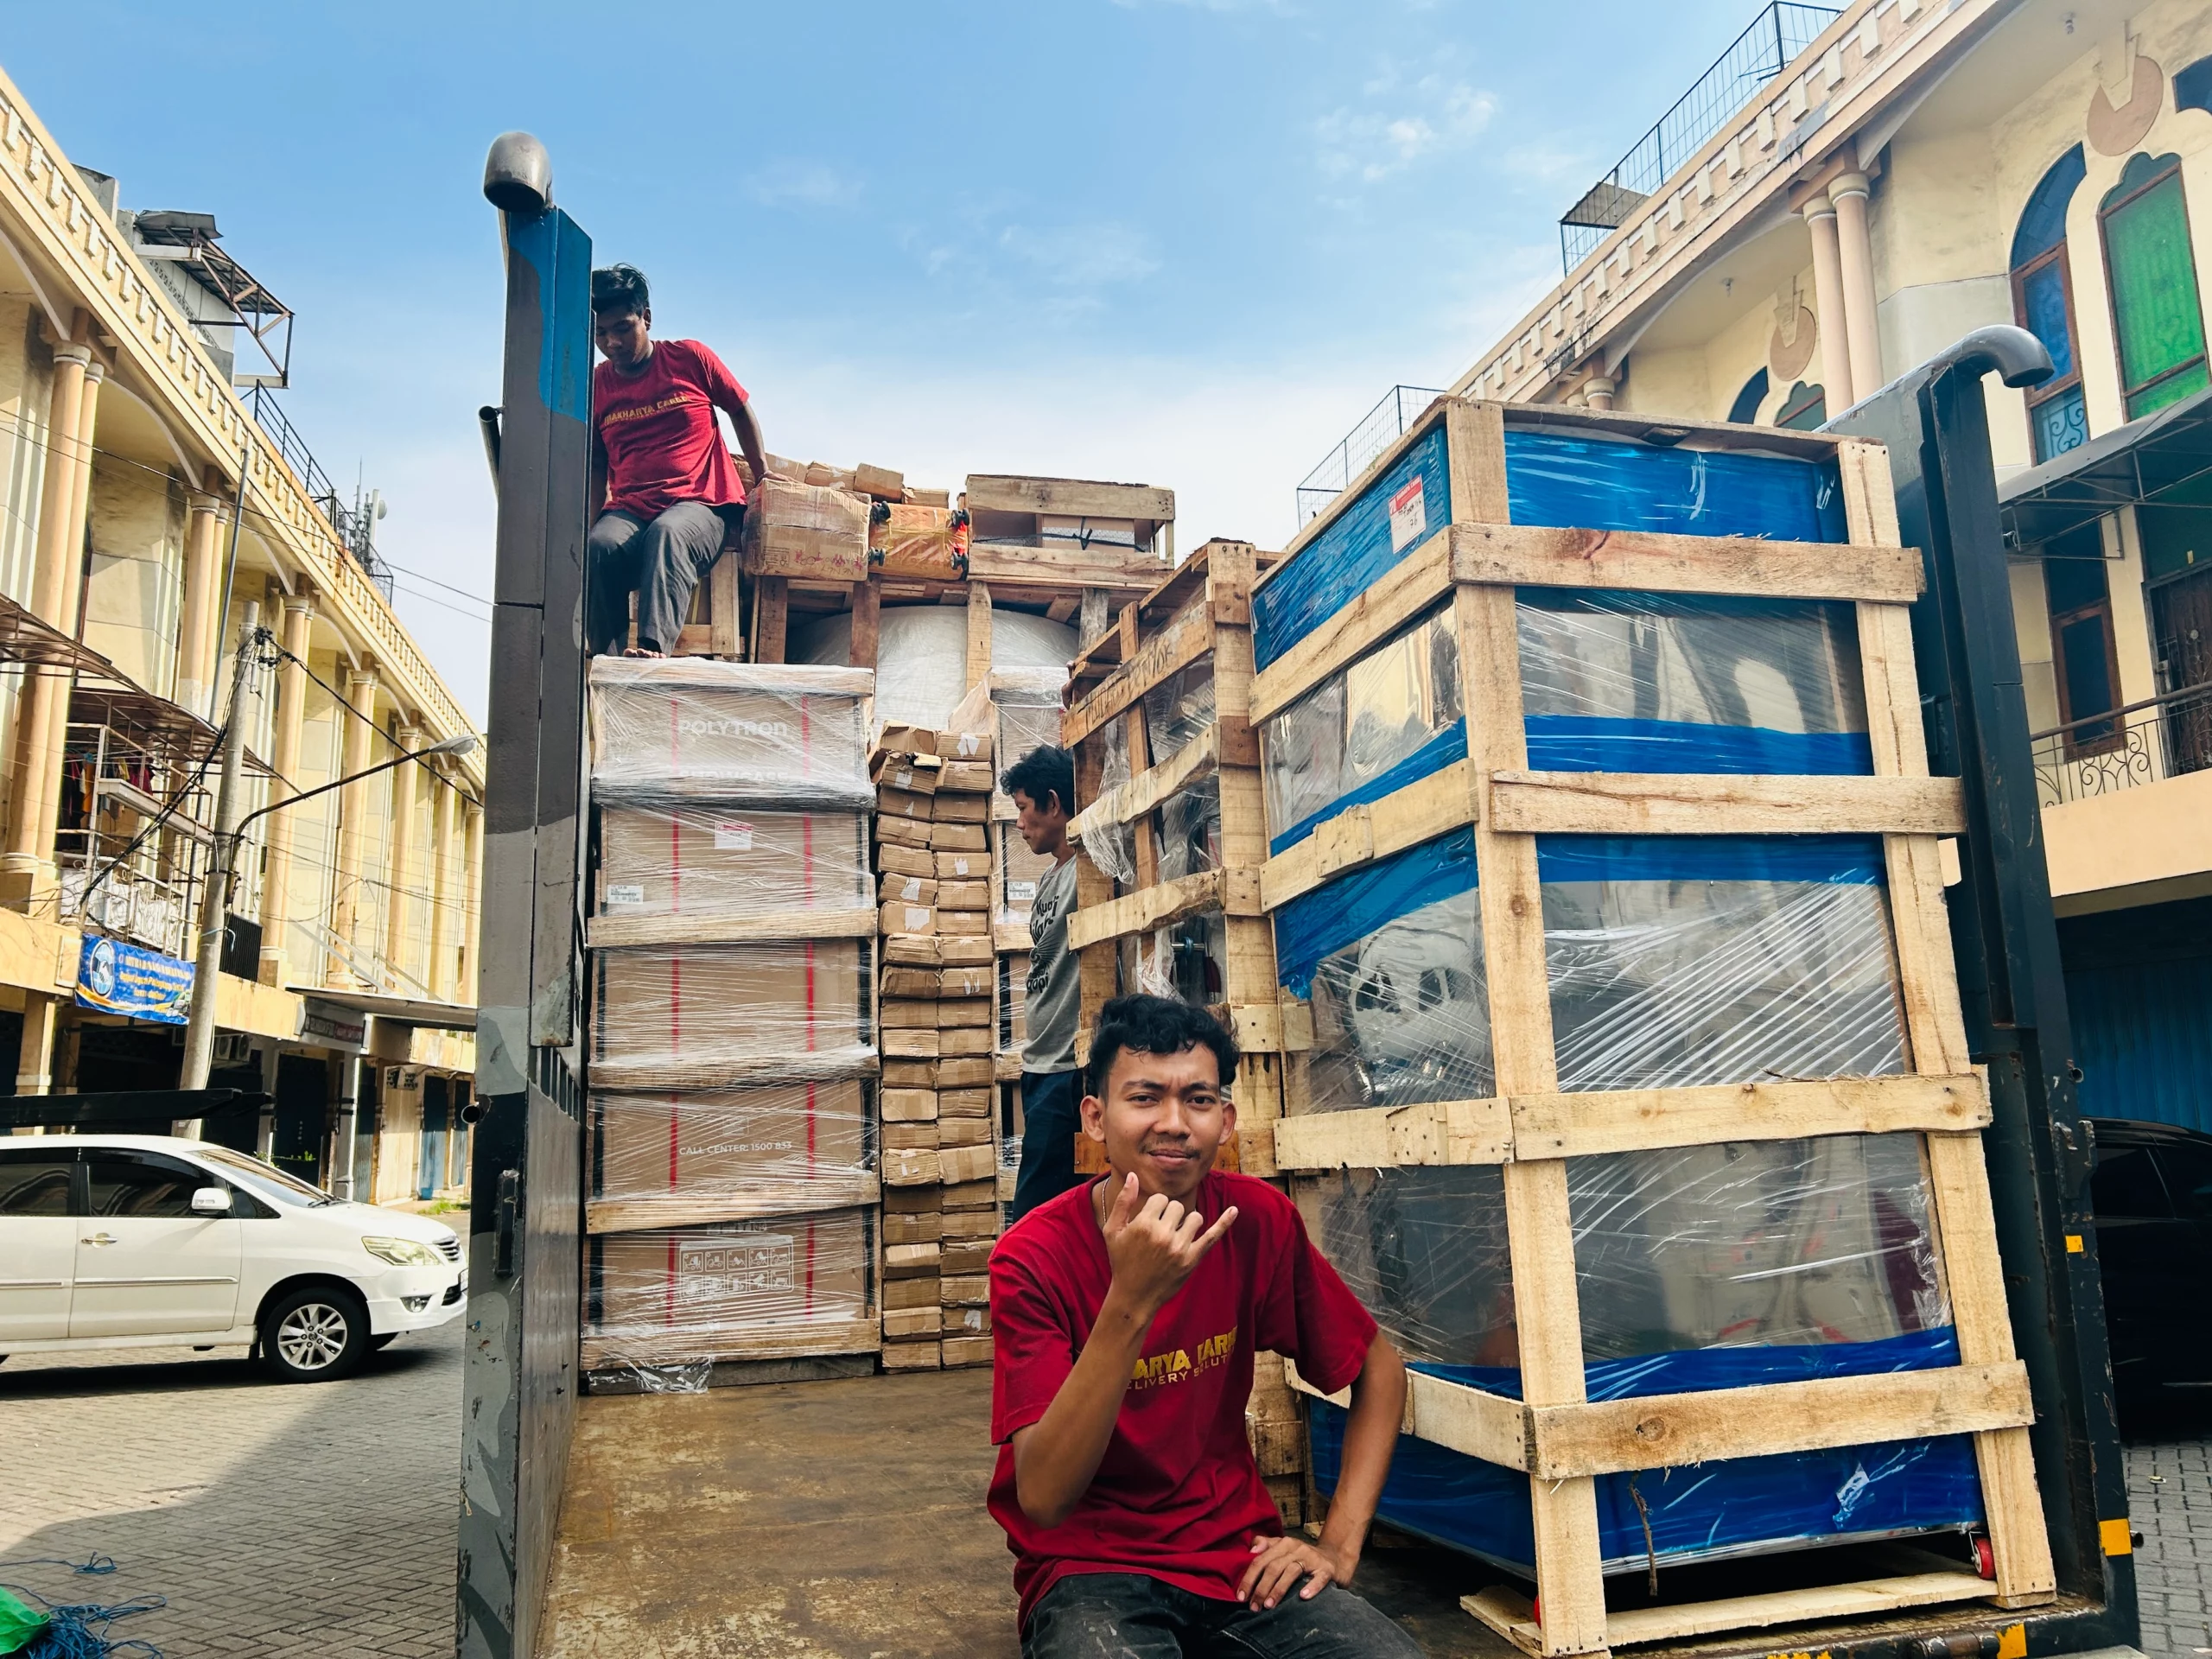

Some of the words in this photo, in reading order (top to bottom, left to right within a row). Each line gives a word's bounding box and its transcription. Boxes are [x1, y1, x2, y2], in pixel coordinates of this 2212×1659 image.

[678, 720, 787, 736] POLYTRON
[679, 1147, 705, 1155] CALL
[708, 1144, 749, 1154] CENTER:
[752, 1142, 772, 1151] 1500
[1133, 1349, 1192, 1380] ARYA
